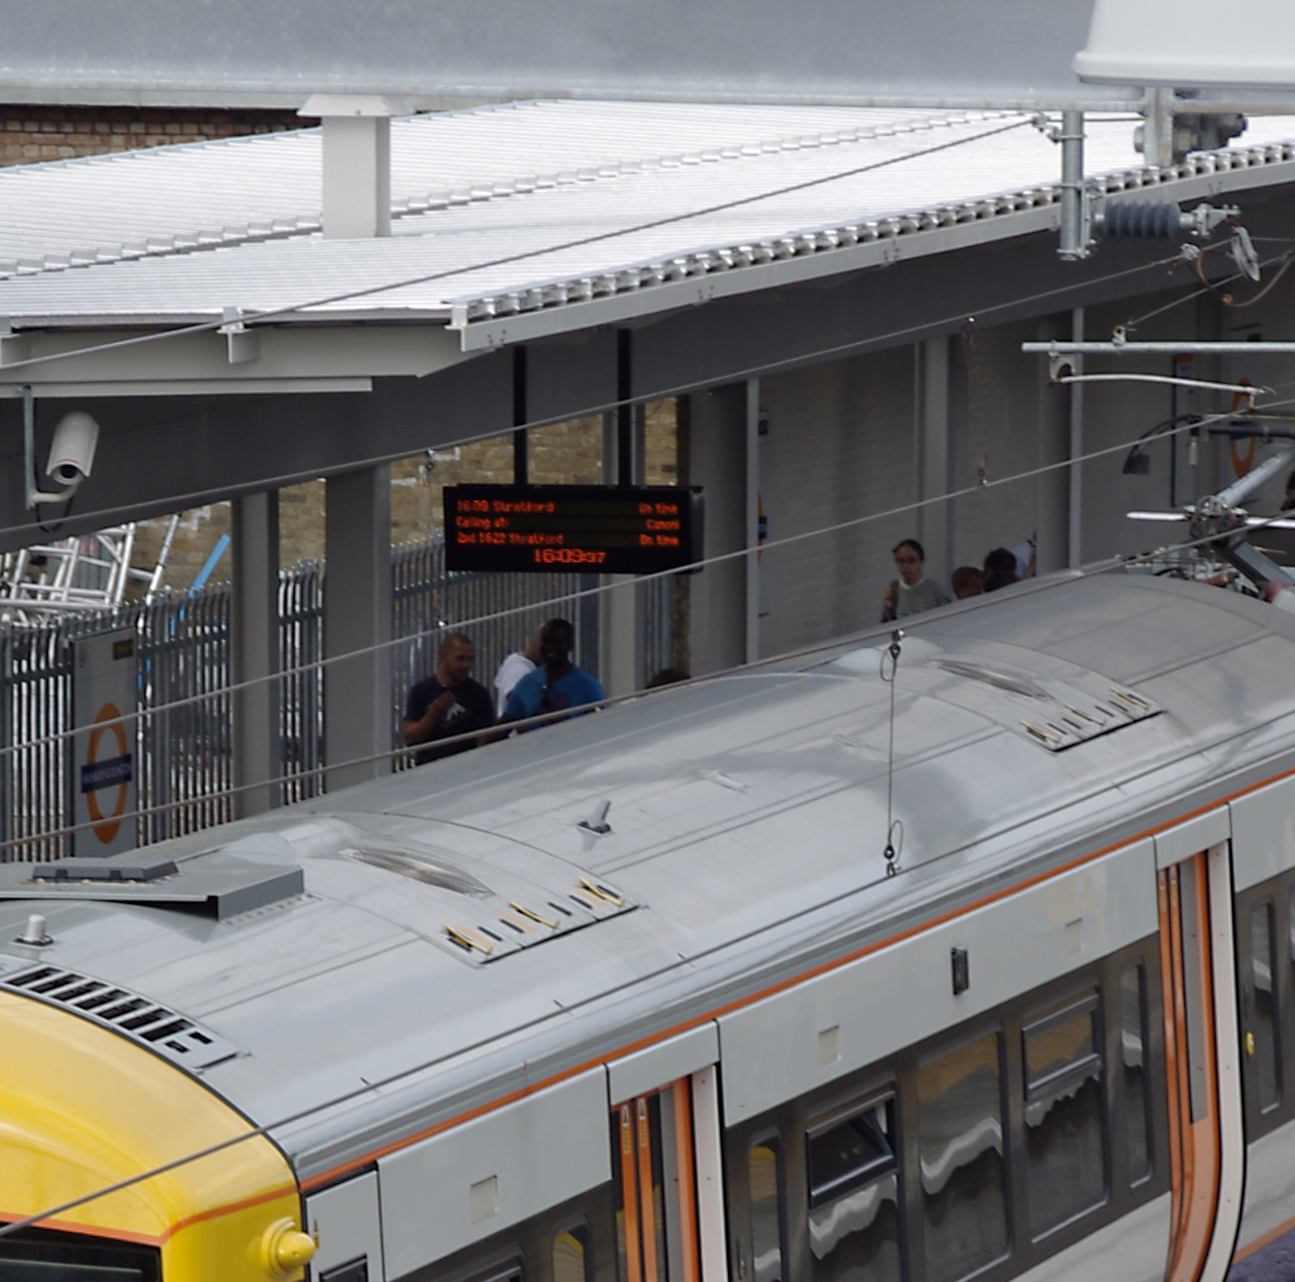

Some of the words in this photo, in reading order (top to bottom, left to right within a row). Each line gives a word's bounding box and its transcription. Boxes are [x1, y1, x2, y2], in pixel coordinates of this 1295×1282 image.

[493, 500, 555, 513] Stratford
[509, 532, 564, 545] Stratford
[533, 548, 607, 563] 16:09:37
